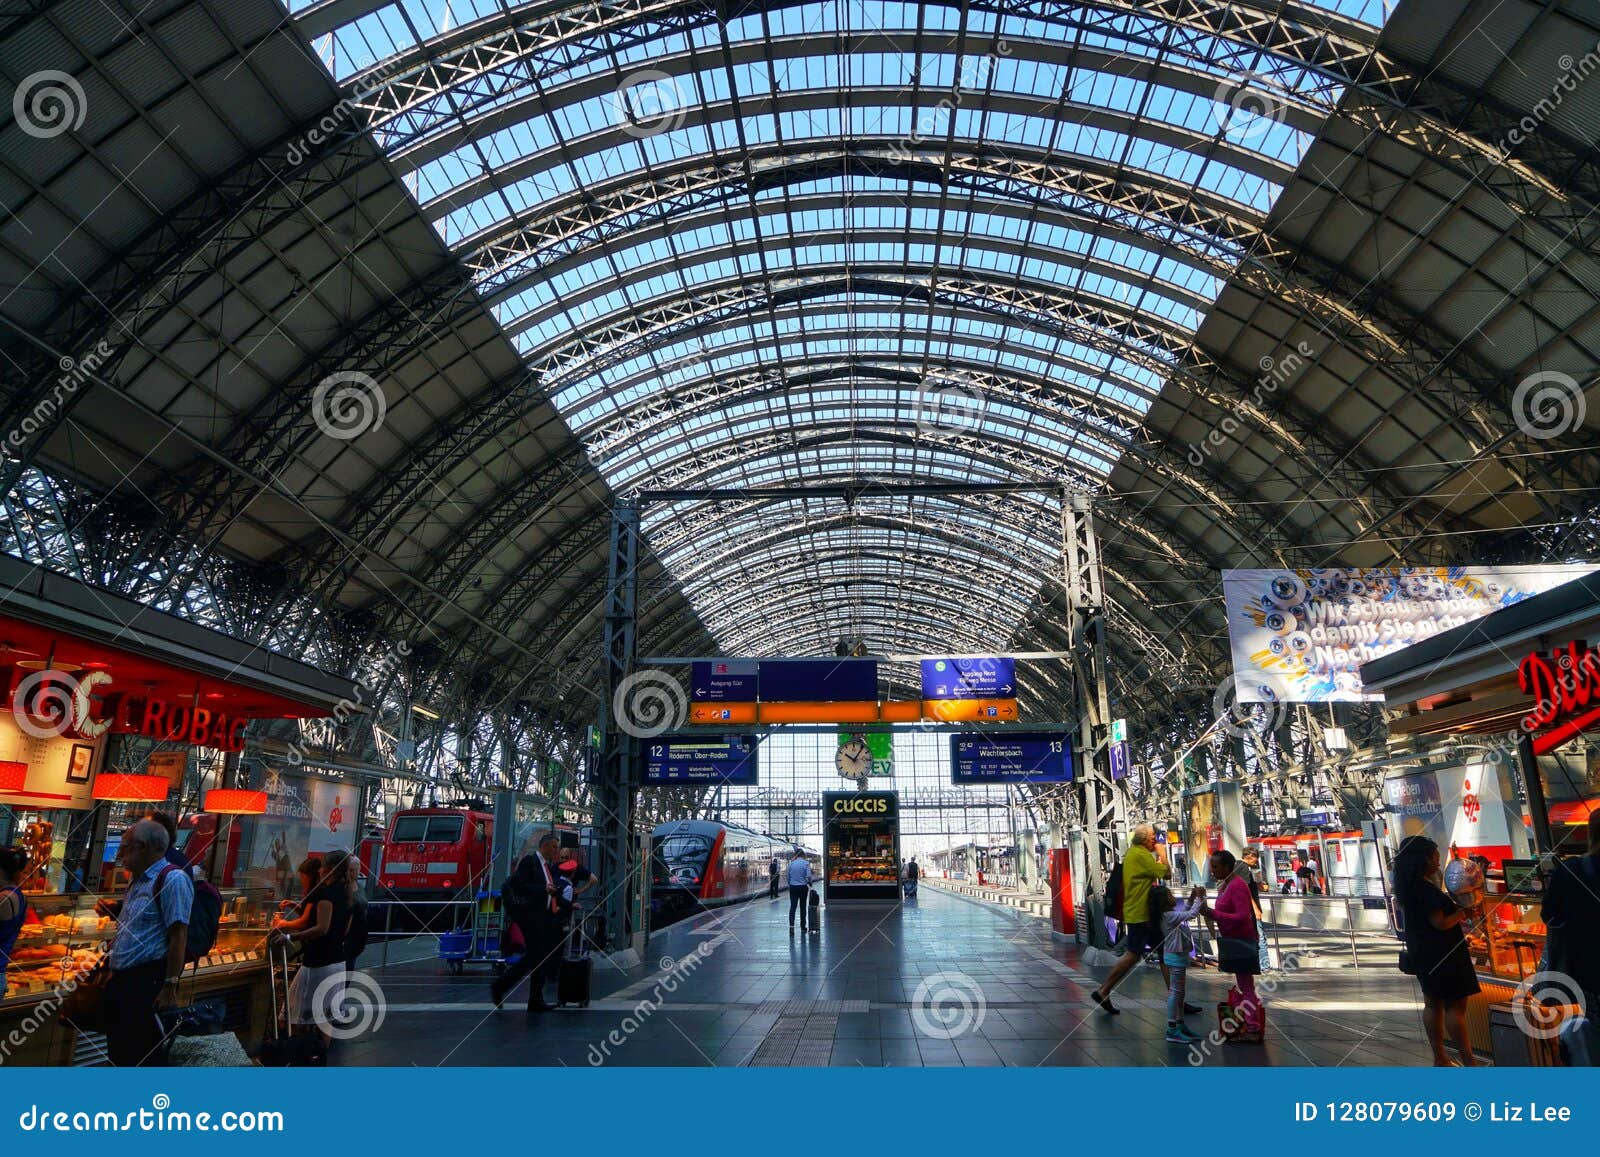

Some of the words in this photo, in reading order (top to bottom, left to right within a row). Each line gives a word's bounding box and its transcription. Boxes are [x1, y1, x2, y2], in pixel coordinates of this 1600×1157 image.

[1303, 602, 1344, 623] Wir
[1349, 600, 1434, 621] schauen
[1310, 621, 1379, 644] damit
[1379, 618, 1416, 641] Sie
[650, 745, 663, 757] 12
[1049, 741, 1063, 753] 13
[1114, 744, 1125, 771] 13
[833, 799, 888, 813] CUCCIS
[414, 864, 425, 873] DB
